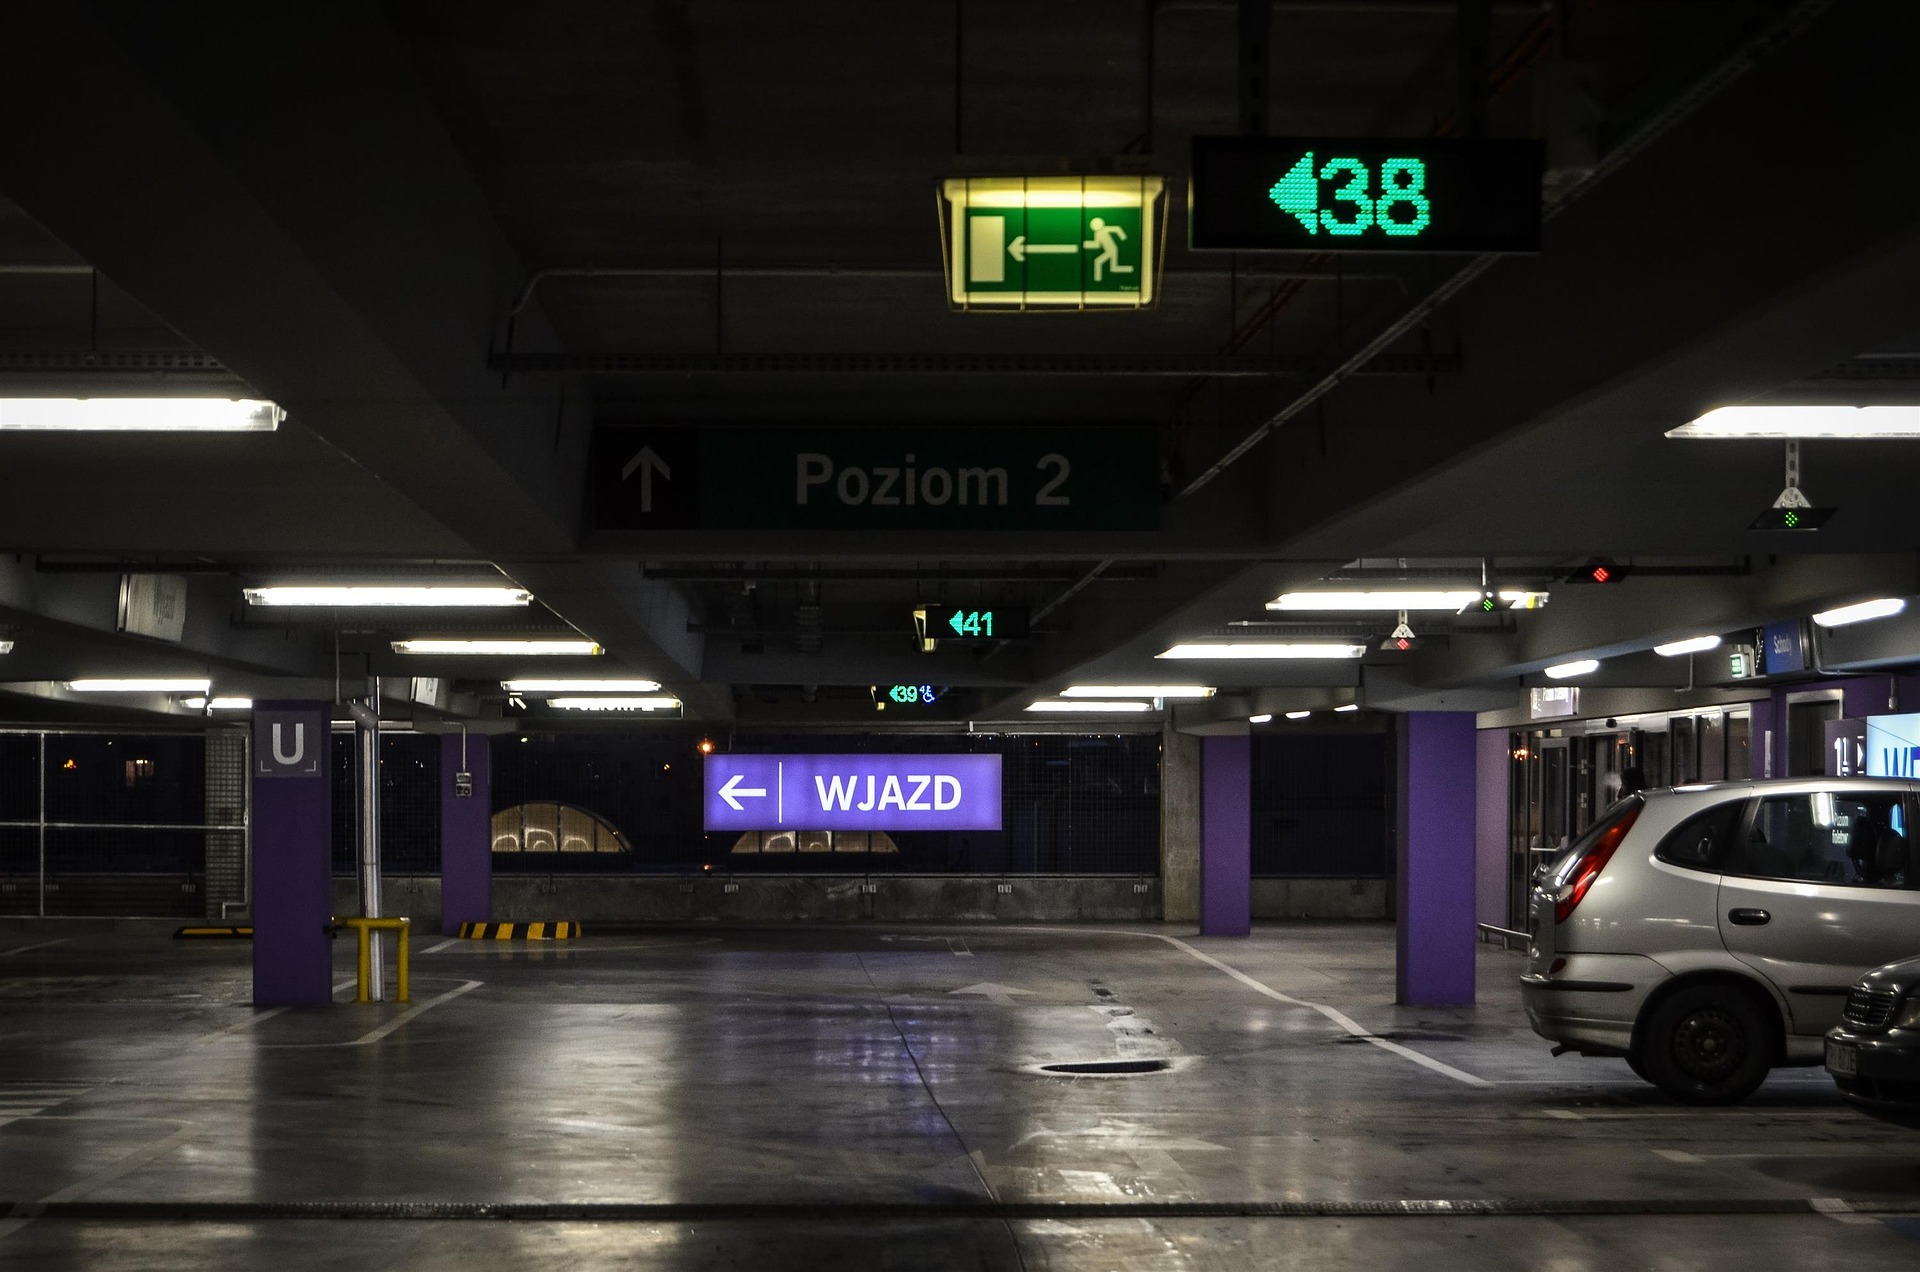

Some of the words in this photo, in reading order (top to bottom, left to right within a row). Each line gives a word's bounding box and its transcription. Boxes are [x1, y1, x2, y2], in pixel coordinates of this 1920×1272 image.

[1320, 158, 1429, 235] 38
[796, 453, 1008, 506] Poziom
[1035, 453, 1071, 506] 2
[963, 611, 992, 636] 41
[897, 686, 918, 702] 39
[272, 723, 304, 765] U
[814, 775, 962, 811] WJAZD
